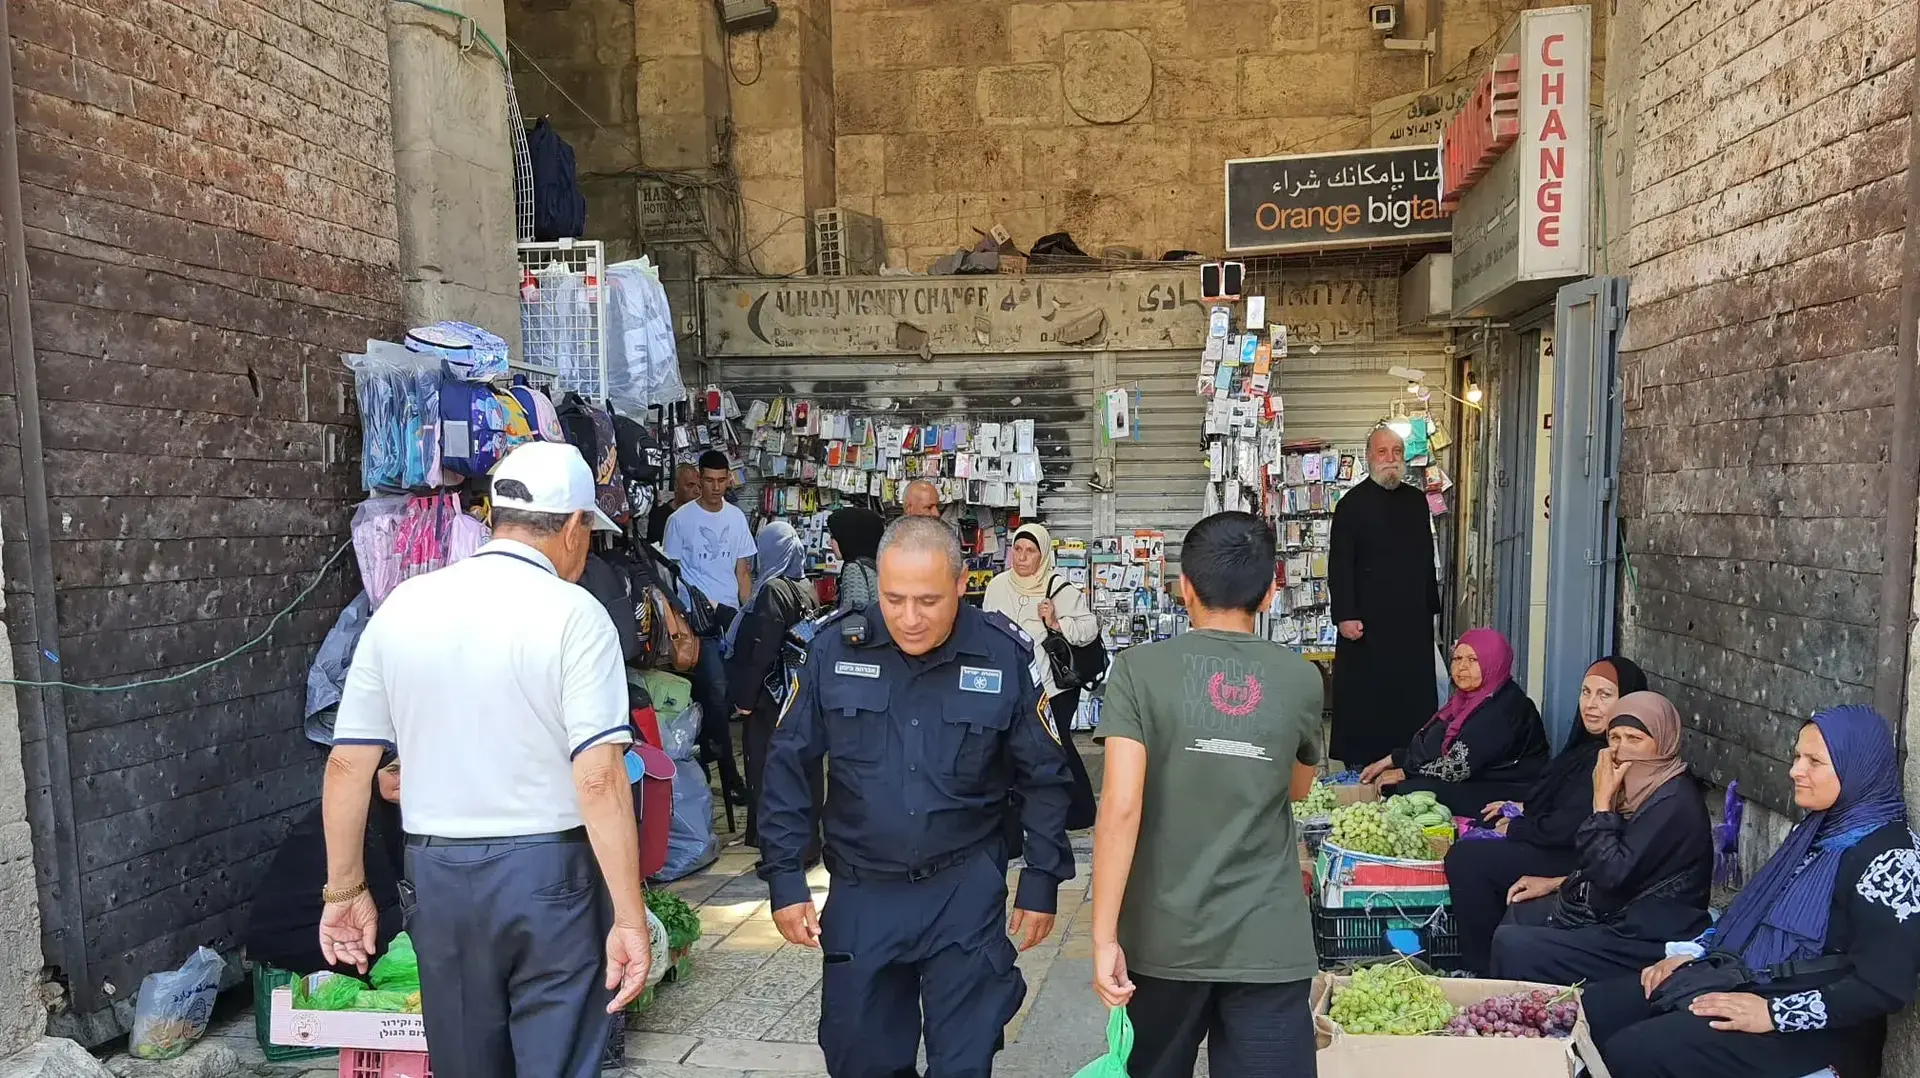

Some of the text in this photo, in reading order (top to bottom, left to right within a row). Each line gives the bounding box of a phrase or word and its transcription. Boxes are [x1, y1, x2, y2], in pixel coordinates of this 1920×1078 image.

[1536, 34, 1567, 247] CHANGE
[1272, 169, 1321, 197] شراء
[1327, 161, 1405, 192] بإمكانك
[1255, 202, 1361, 233] Orange
[847, 288, 909, 316] MONEY
[379, 1029, 405, 1039] הגולן
[380, 1019, 411, 1028] וקירור
